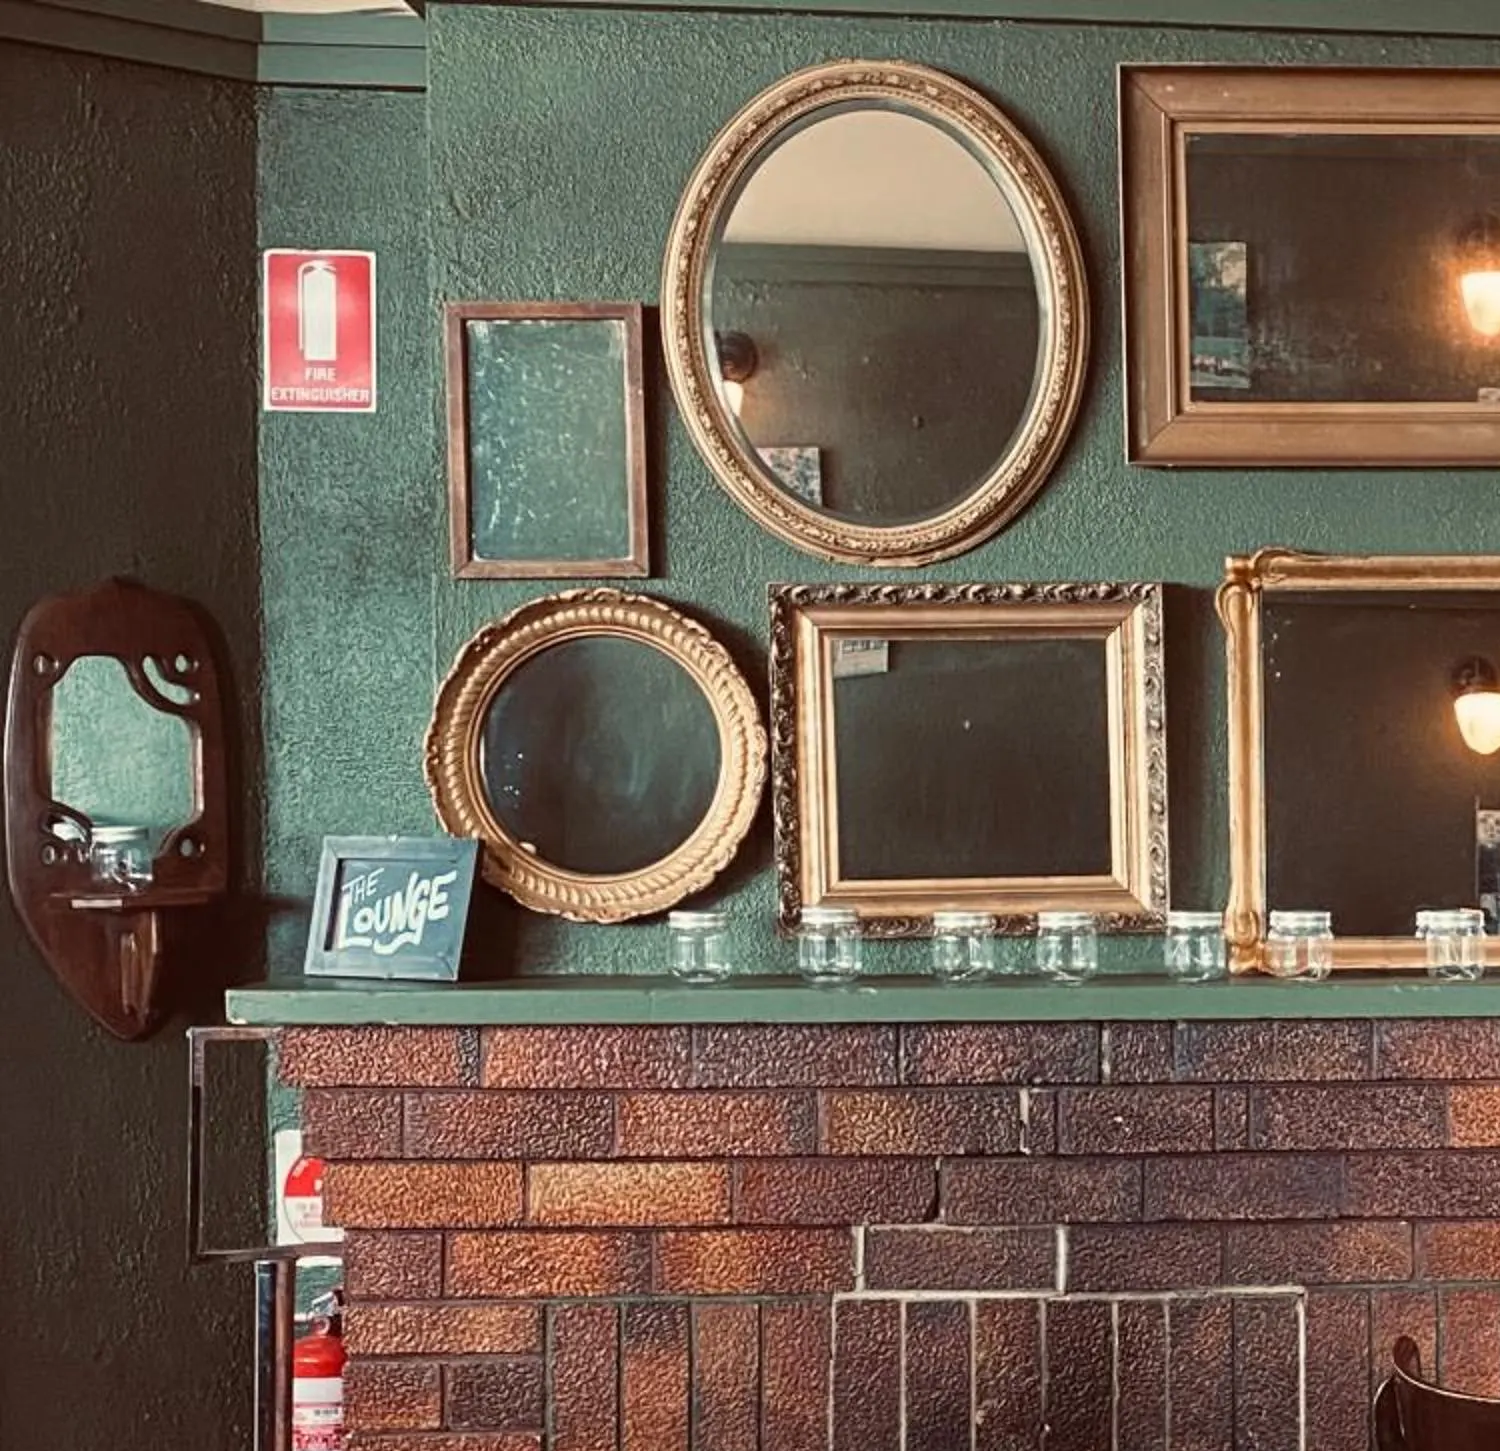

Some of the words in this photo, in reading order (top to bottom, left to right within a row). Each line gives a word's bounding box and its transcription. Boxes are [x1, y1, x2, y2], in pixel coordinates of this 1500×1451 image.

[304, 367, 337, 381] FIRE
[271, 387, 369, 402] EXTINGUISHER
[341, 868, 385, 904] THE
[334, 870, 458, 952] LOUNGE
